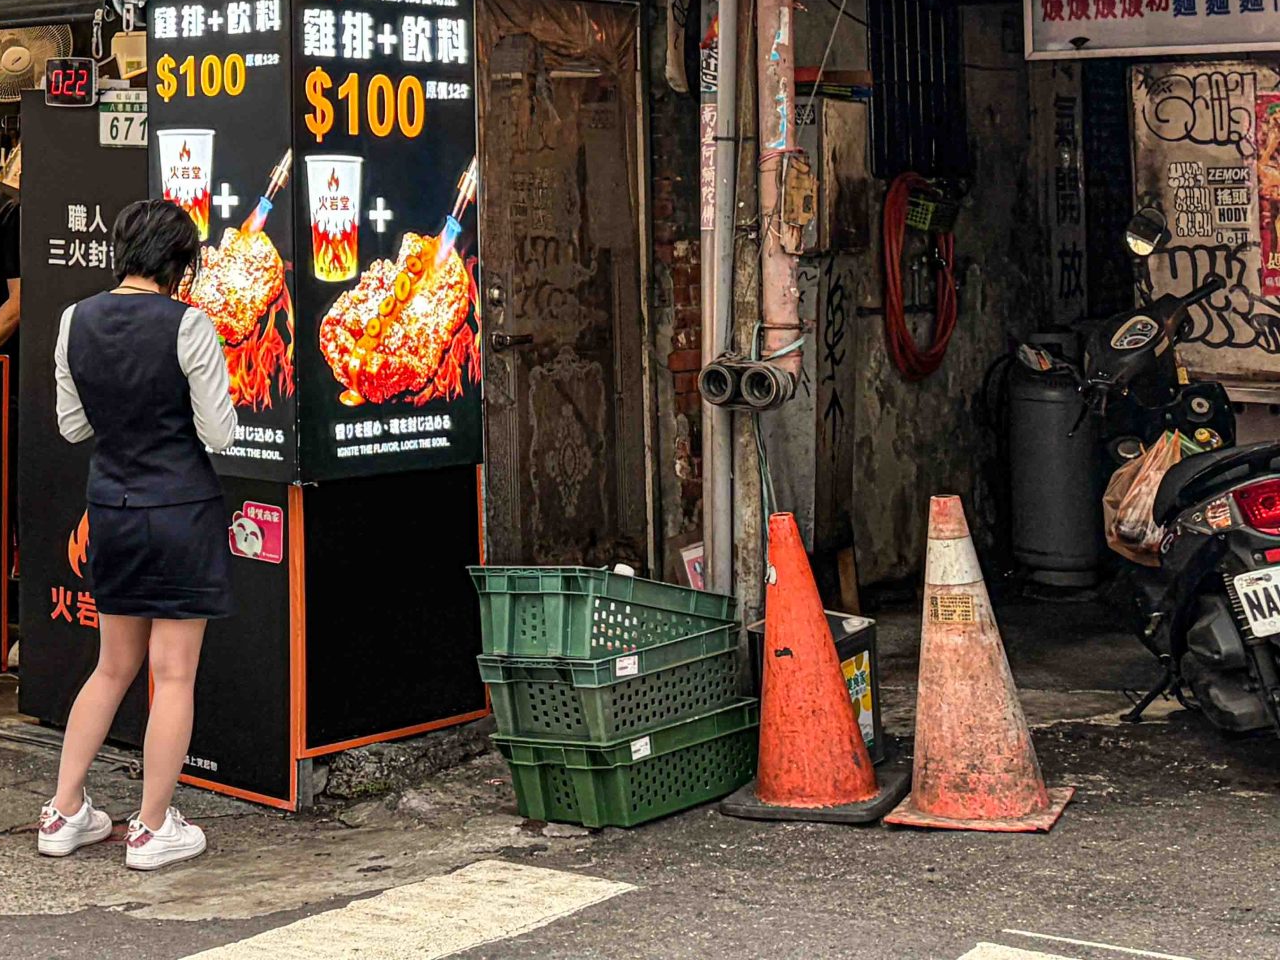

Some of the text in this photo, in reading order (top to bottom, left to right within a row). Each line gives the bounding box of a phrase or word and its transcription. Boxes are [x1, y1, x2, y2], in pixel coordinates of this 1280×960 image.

[303, 8, 468, 64] 雞排+飲料
[51, 69, 88, 97] 022
[156, 53, 246, 103] $100
[305, 66, 426, 143] $100
[109, 116, 148, 142] 671
[170, 165, 202, 180] 火岩堂
[1208, 168, 1249, 181] ZEMOK
[318, 195, 350, 211] 火岩堂
[1216, 188, 1248, 205] 搖頭
[67, 204, 108, 234] 職人
[48, 238, 116, 269] 三火封
[226, 446, 246, 457] LOCK
[247, 448, 261, 458] THE
[360, 444, 373, 455] THE
[419, 438, 431, 449] THE
[50, 584, 100, 630] 火岩
[1243, 584, 1280, 622] NA
